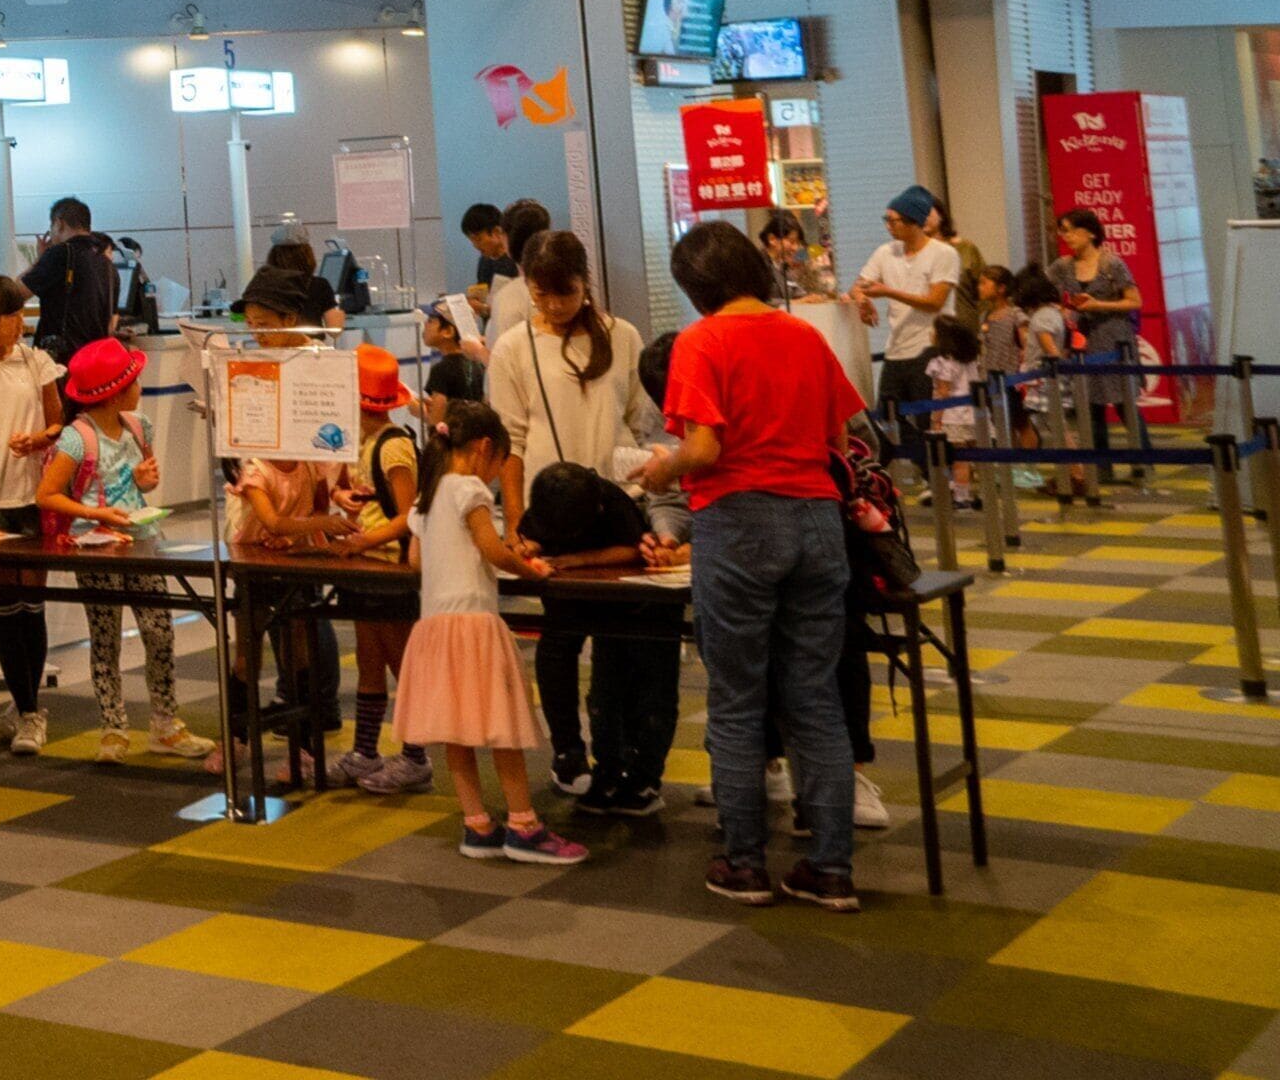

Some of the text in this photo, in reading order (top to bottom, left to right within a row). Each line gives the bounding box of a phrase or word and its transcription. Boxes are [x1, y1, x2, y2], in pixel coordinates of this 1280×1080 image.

[223, 39, 236, 68] 5
[181, 74, 197, 102] 5
[1082, 173, 1111, 189] GET
[1074, 190, 1123, 206] READY
[1111, 207, 1125, 221] A
